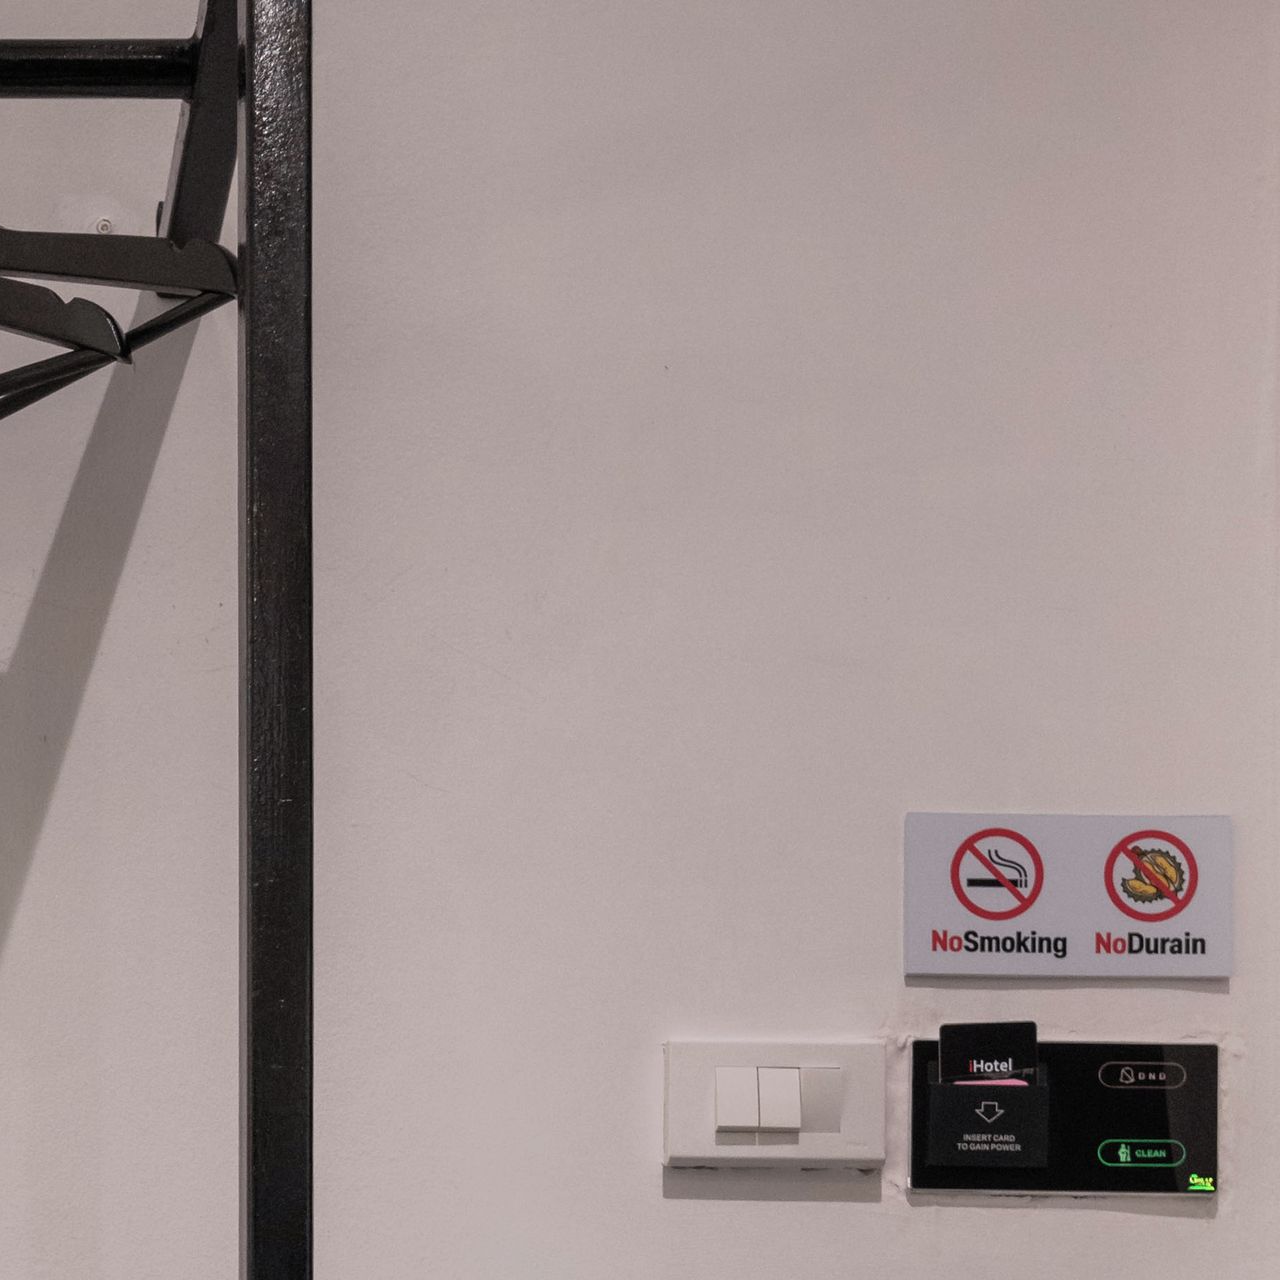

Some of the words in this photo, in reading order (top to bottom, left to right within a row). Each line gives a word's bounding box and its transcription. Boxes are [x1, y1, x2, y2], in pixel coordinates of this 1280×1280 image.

[969, 1058, 1013, 1073] iHotel
[963, 1134, 992, 1142] INSERT
[993, 1134, 1016, 1143] CARD
[957, 1143, 969, 1151] TO
[970, 1143, 990, 1151] GAIN
[990, 1143, 1022, 1152] POWER
[1135, 1148, 1167, 1158] CLEAN
